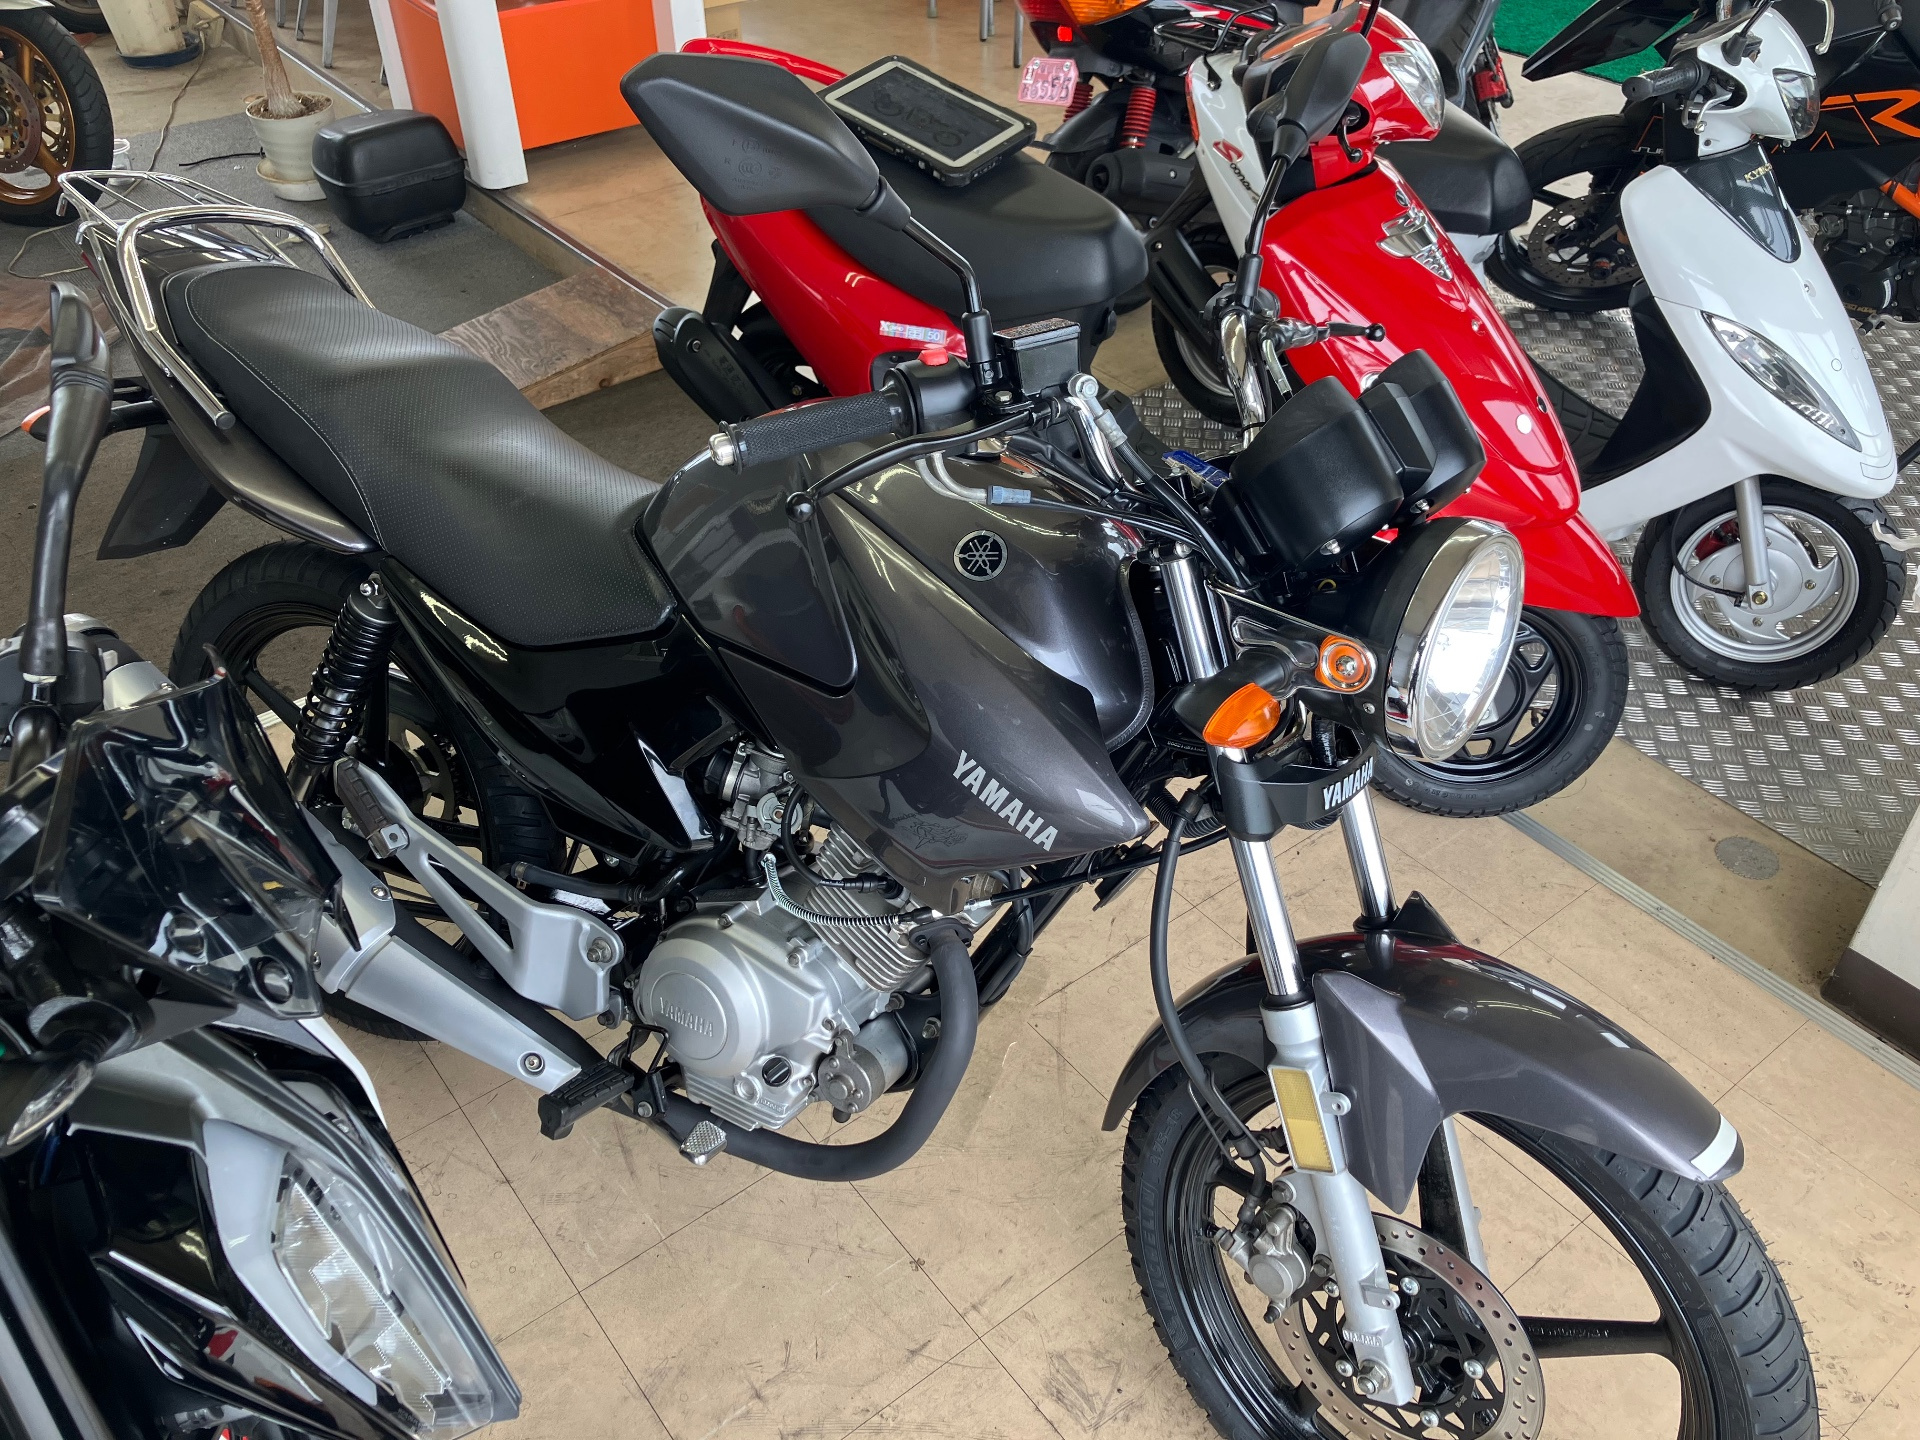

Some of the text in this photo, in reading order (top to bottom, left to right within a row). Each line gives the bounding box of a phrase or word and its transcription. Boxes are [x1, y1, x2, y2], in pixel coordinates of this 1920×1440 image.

[952, 749, 1059, 852] YAMAHA
[1323, 756, 1374, 810] YAMAHA
[659, 997, 713, 1037] YAMAHA
